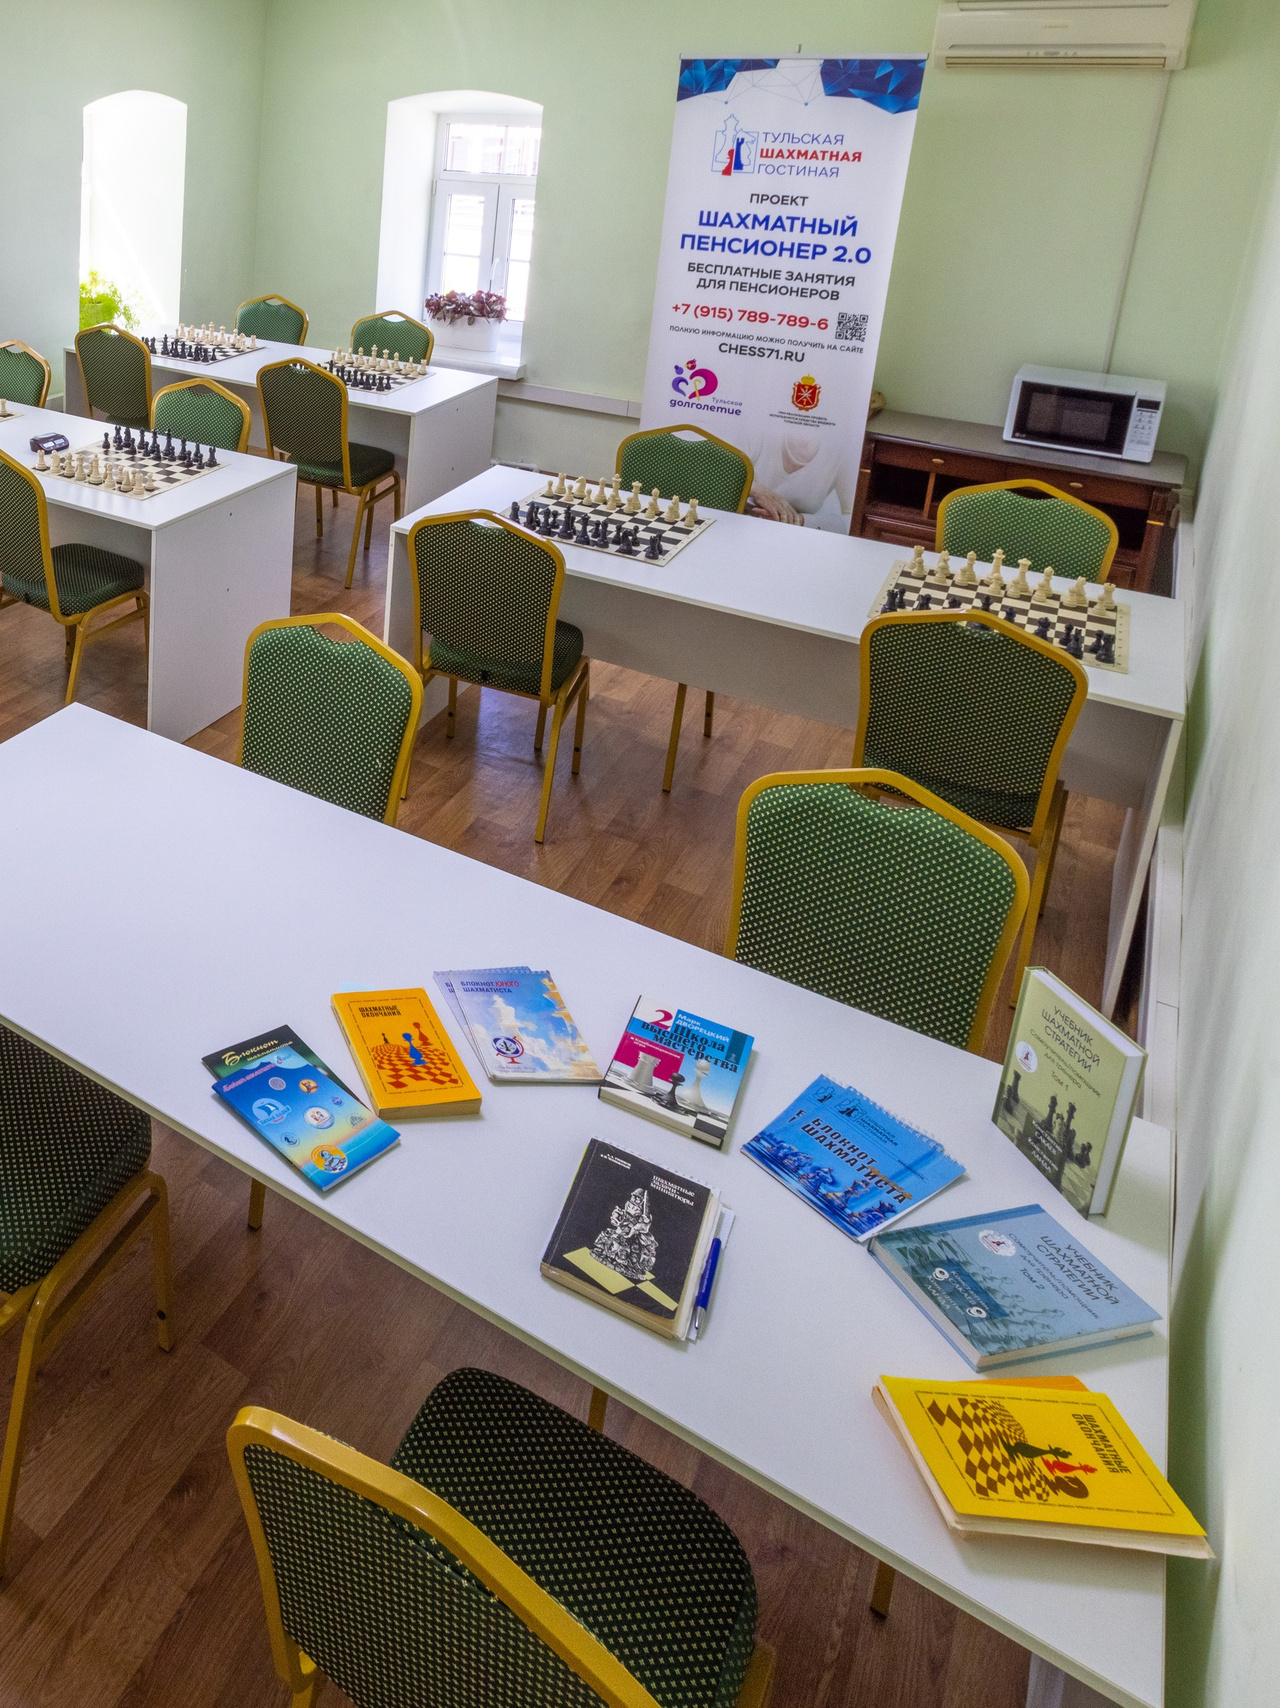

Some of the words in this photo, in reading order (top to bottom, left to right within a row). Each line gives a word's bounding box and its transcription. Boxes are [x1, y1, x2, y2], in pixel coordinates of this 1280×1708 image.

[762, 131, 844, 146] ТУЛЬСКАЯ
[759, 148, 862, 163] ШАХМАТНАЯ
[757, 163, 840, 178] ГОСТИНАЯ
[750, 193, 809, 207] ПРОЕКТ
[698, 210, 859, 237] ШАХМАТНЫЙ
[680, 233, 827, 261] ПЕНСИОНЕР
[832, 246, 872, 265] 2.0
[687, 262, 782, 280] БЕСПЛАТНЫЕ
[785, 270, 855, 287] ЗАНЯТИЯ
[696, 278, 726, 291] ДЛЯ
[729, 280, 840, 301] ПЕНСИОНЕРОВ
[672, 303, 691, 316] +7
[693, 304, 734, 323] (915)
[737, 309, 829, 330] 789-789-6
[669, 325, 700, 334] ПОЛНУЮ
[701, 330, 754, 340] ИНФОРМАЦИЮ
[755, 336, 786, 344] МОЖНО
[787, 339, 825, 349] ПОЛУЧИТЬ
[839, 345, 864, 354] САЙТЕ
[718, 342, 805, 363] CHESS71.RU
[669, 399, 742, 416] долголетие
[712, 397, 743, 406] Тульское
[358, 1005, 398, 1013] ШАХМАТНЫЕ
[361, 1010, 402, 1018] ОКОНЧАНИЯ
[649, 1009, 673, 1030] 2
[678, 1013, 701, 1026] Марк
[641, 1021, 707, 1053] высшего
[673, 1025, 726, 1053] Школа
[675, 1019, 730, 1043] ДВОРЕЦКИЙ
[1041, 1009, 1100, 1067] ШАХМАТНОЙ
[1054, 1005, 1093, 1046] УЧЕБНИК
[221, 1039, 279, 1067] Блокнот
[652, 1034, 738, 1073] мастерства
[1044, 1025, 1092, 1073] СТРАТЕГИИ
[811, 1117, 878, 1166] БЛОКНОТ
[801, 1123, 907, 1204] ШАХМАТИСТА
[1020, 1267, 1037, 1284] Том
[1036, 1244, 1100, 1301] СТРАТЕГИИ
[1040, 1235, 1119, 1305] ШАХМАТНОЙ
[1065, 1244, 1118, 1291] УЧЕБНИК
[1072, 1413, 1121, 1474] ОКОНЧАНИЯ
[1082, 1414, 1132, 1475] ШАХМАТНЫЕ
